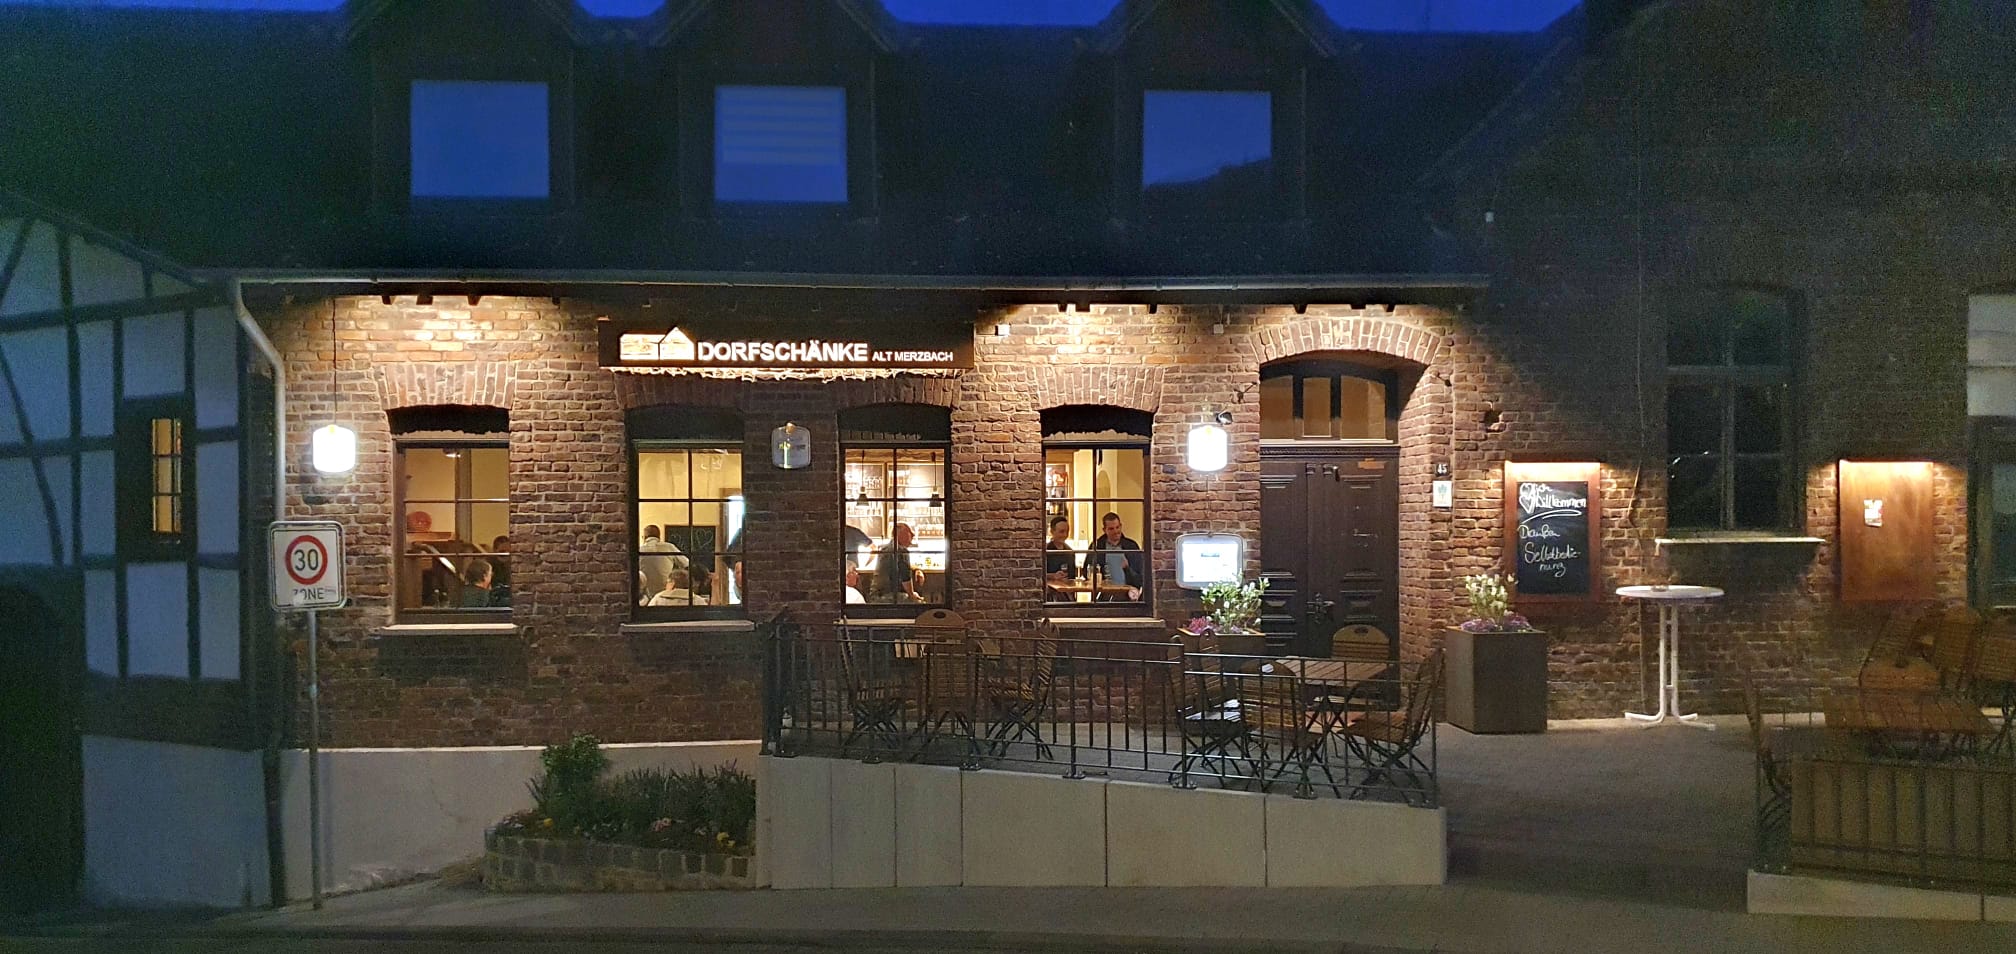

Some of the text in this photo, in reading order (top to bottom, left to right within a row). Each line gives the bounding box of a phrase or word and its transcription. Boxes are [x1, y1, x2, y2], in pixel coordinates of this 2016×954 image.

[698, 339, 954, 362] DORFSCHÄNKE ALT MERZBACH
[1437, 463, 1448, 474] 45
[294, 548, 319, 571] 30
